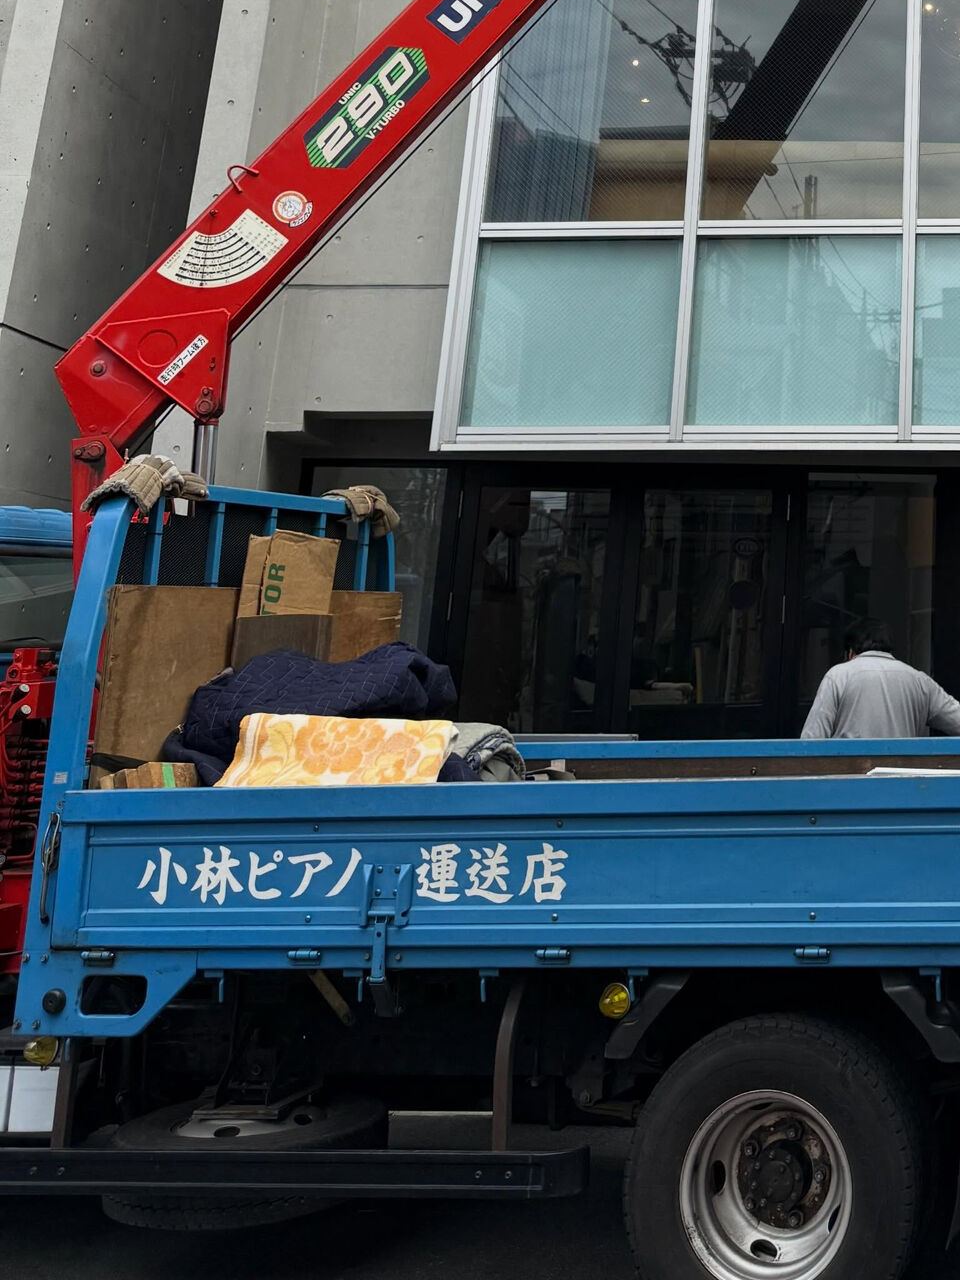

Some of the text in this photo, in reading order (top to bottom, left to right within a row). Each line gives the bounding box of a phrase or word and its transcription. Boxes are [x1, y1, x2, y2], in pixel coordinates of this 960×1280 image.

[316, 51, 414, 163] 290
[338, 82, 362, 105] UNIC
[365, 99, 406, 140] V-TURBO
[136, 842, 569, 906] 小林ピアノ 運送店
